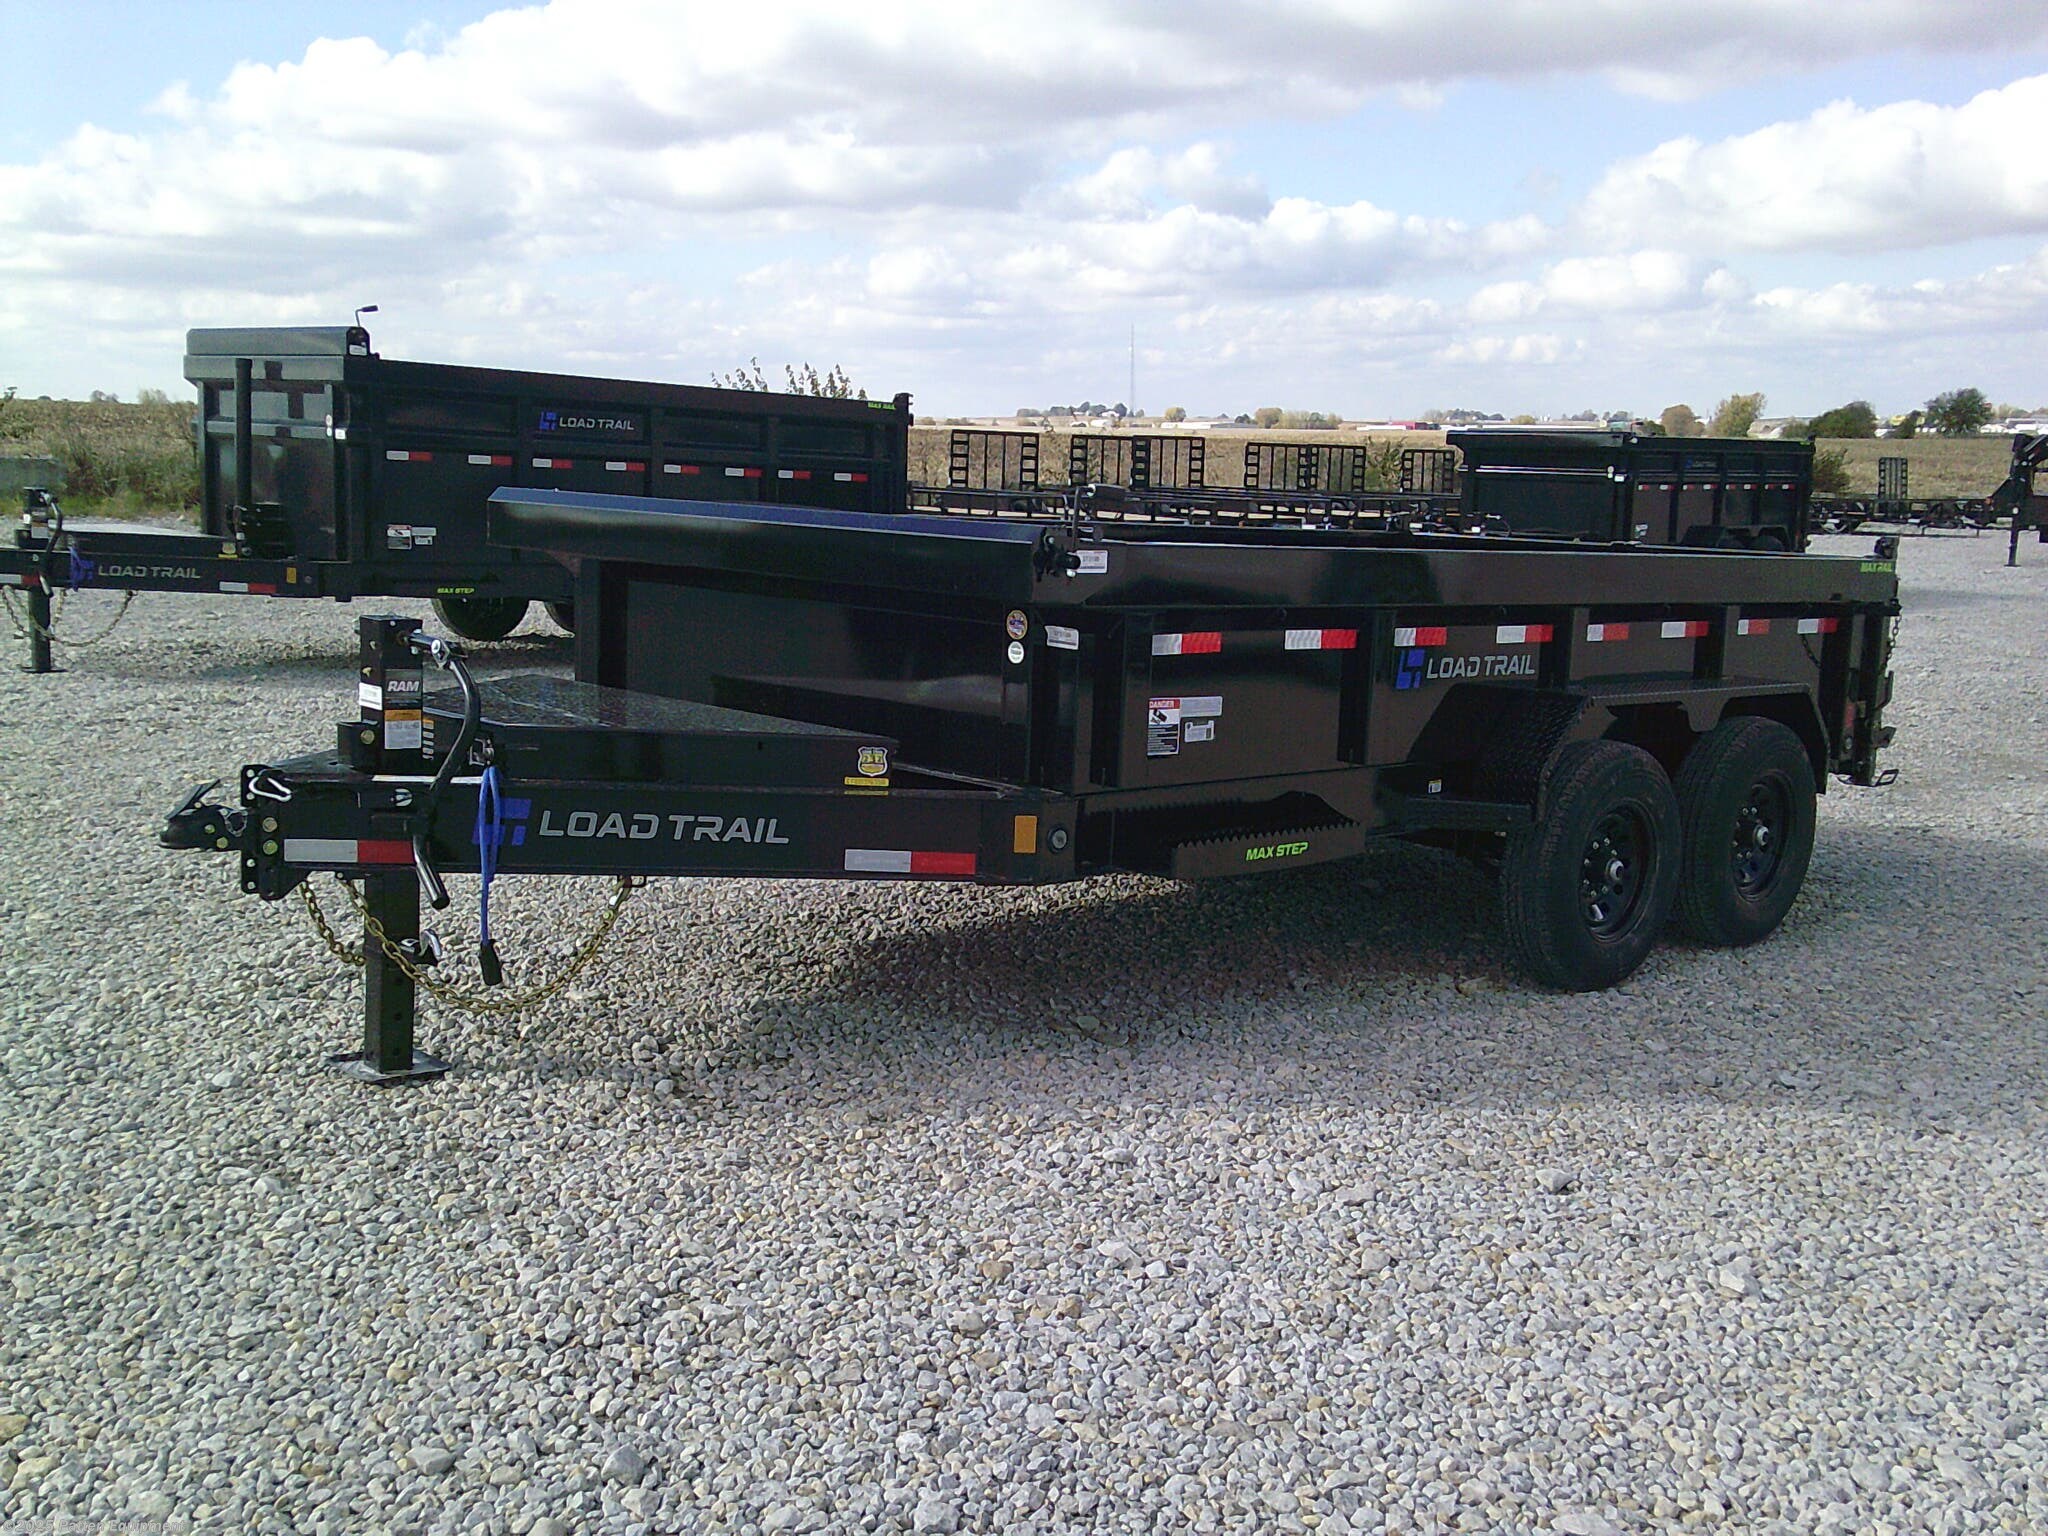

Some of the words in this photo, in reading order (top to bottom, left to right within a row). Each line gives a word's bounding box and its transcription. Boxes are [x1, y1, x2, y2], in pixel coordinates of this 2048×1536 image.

[559, 416, 596, 429] LOAD
[596, 418, 635, 431] TRAIL
[97, 564, 147, 577] LOAD
[149, 566, 202, 579] TRAIL
[1426, 656, 1480, 679] LOAD
[1484, 654, 1536, 676] TRAIL
[387, 680, 420, 692] RAM
[539, 809, 659, 839] LOAD
[668, 813, 790, 844] TRAIL
[1245, 846, 1275, 861] MAX
[1276, 841, 1309, 857] STEP
